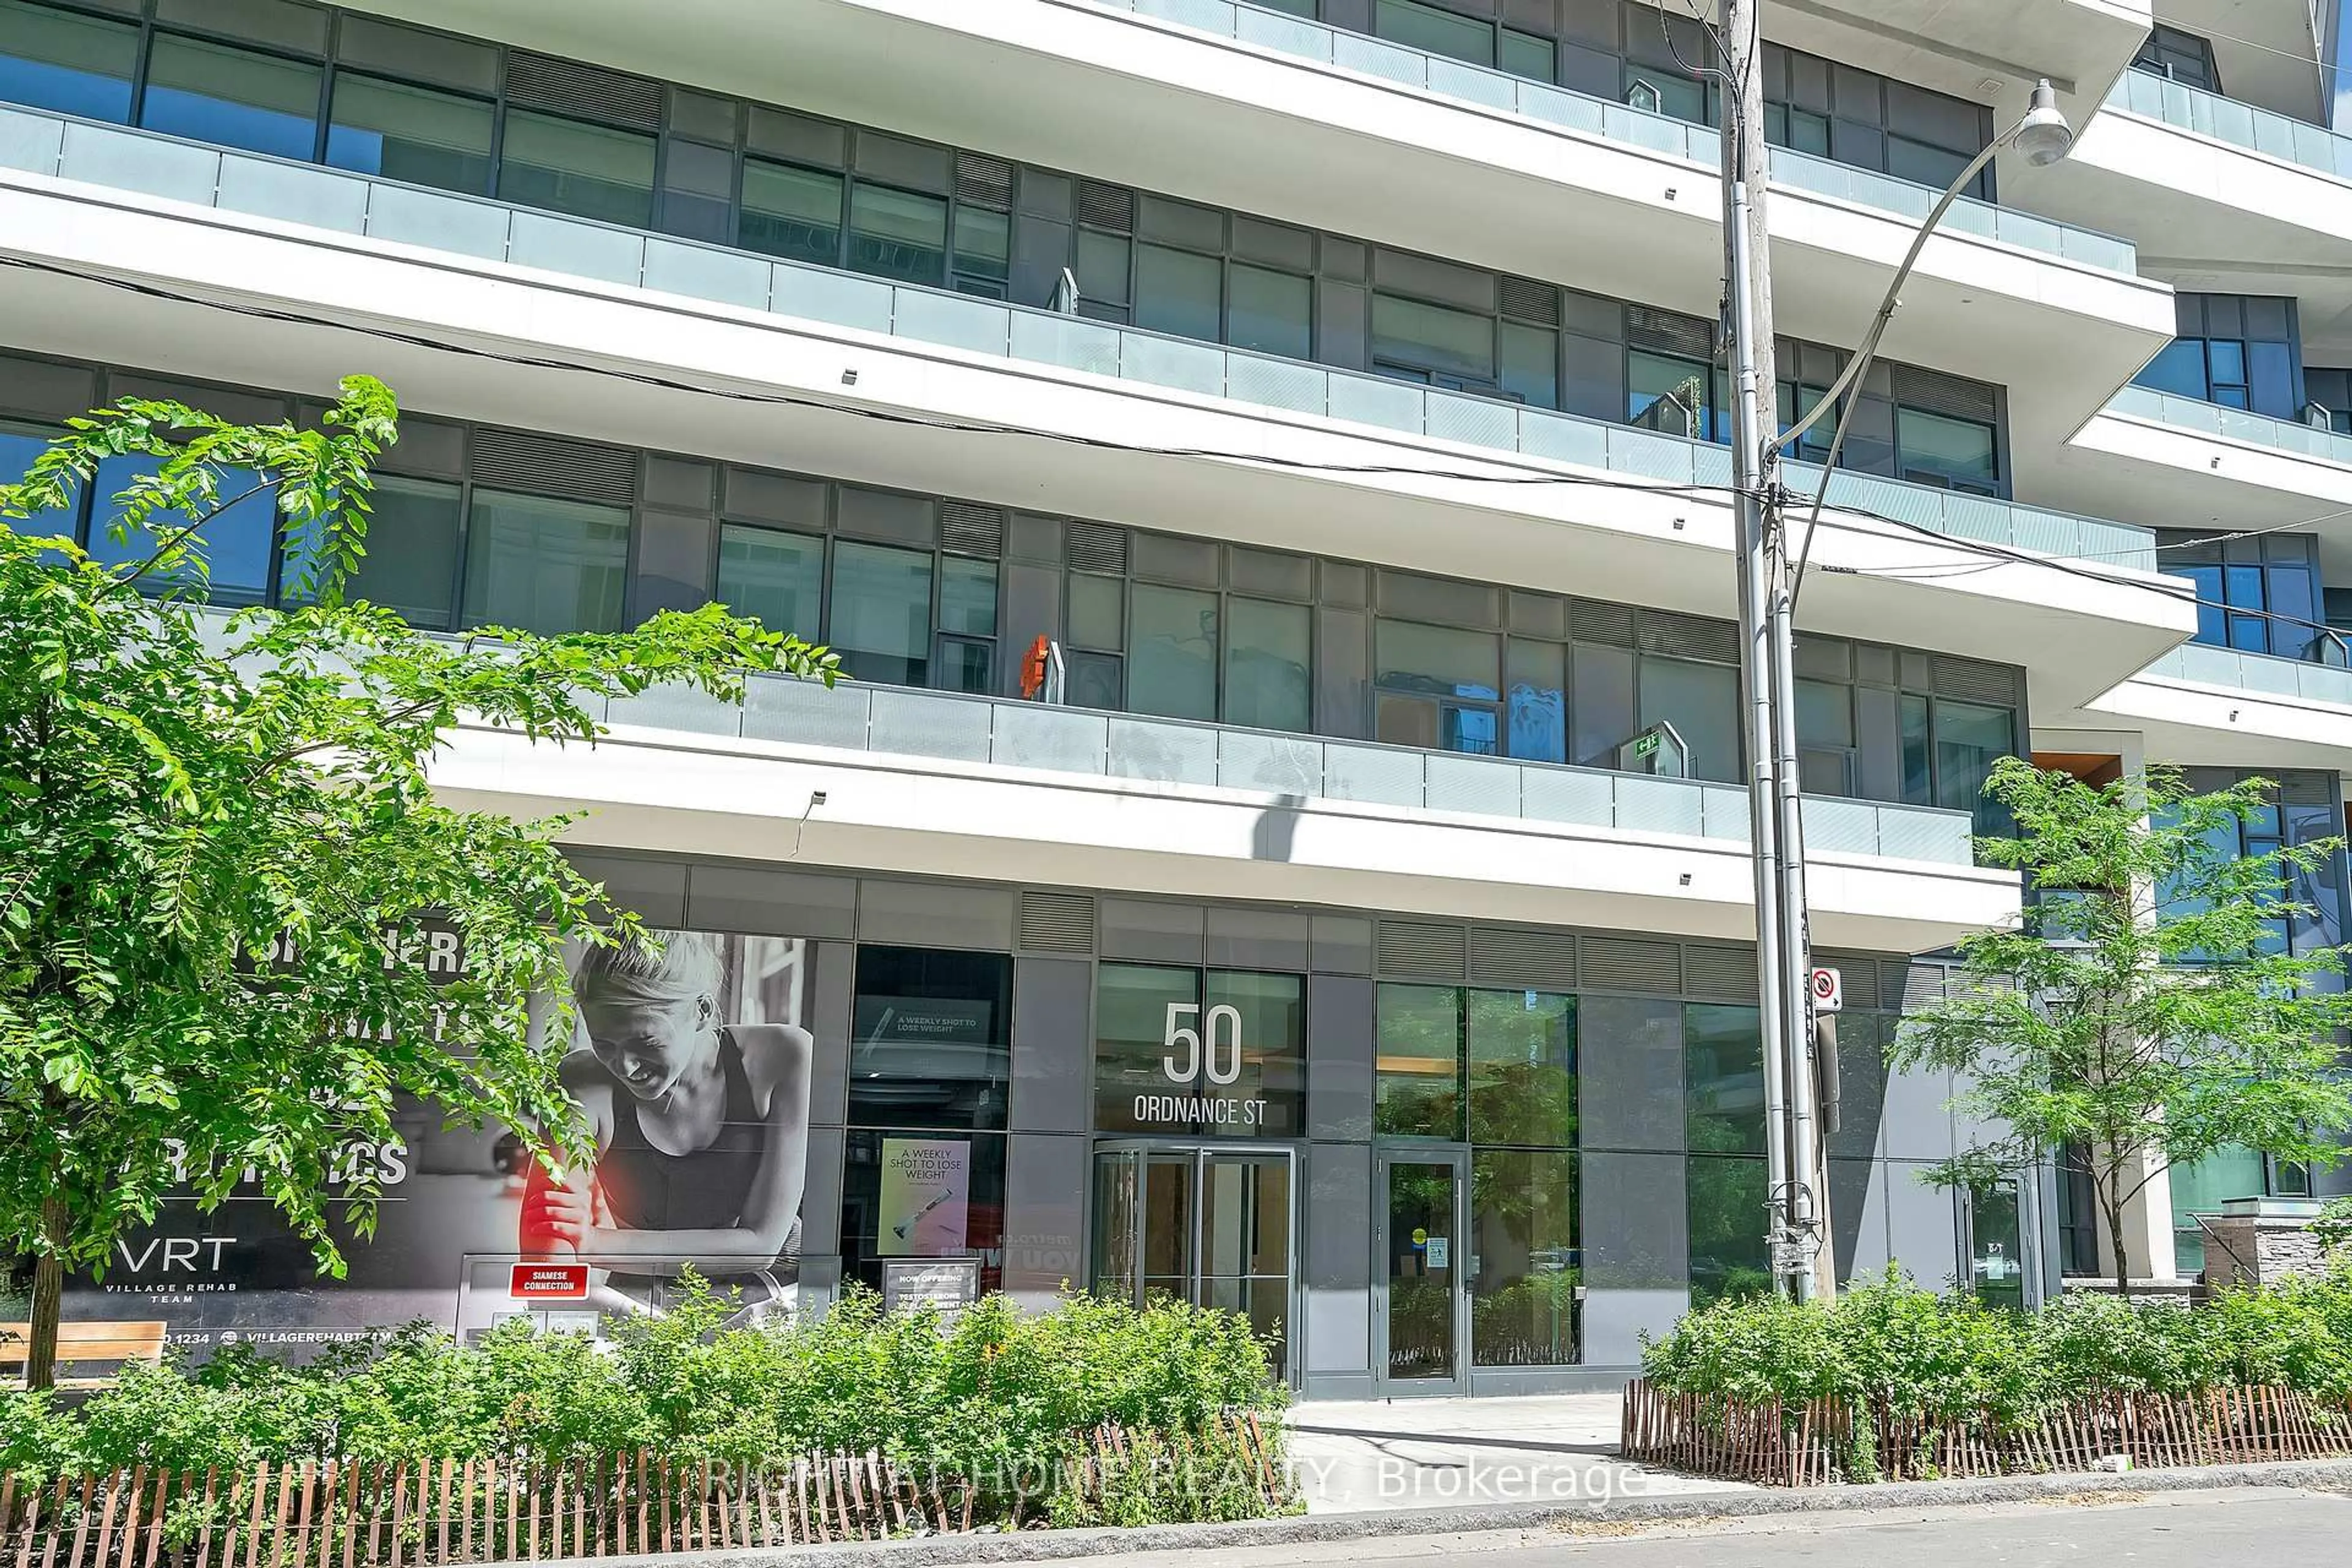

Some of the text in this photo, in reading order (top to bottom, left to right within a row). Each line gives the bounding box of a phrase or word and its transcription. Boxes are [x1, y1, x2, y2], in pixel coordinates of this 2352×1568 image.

[906, 1016, 941, 1025] WEEKLY
[1164, 1003, 1242, 1084] 50
[1134, 1095, 1267, 1125] ORDNANCE ST
[912, 1150, 951, 1159] WEEKLY
[890, 1159, 961, 1169] SHOT TO LOSE
[906, 1169, 946, 1179] WEIGHT
[117, 1238, 238, 1273] VRT
[106, 1284, 176, 1293] VILLAGE
[151, 1295, 192, 1304] TEAM
[176, 1334, 209, 1344] 1234
